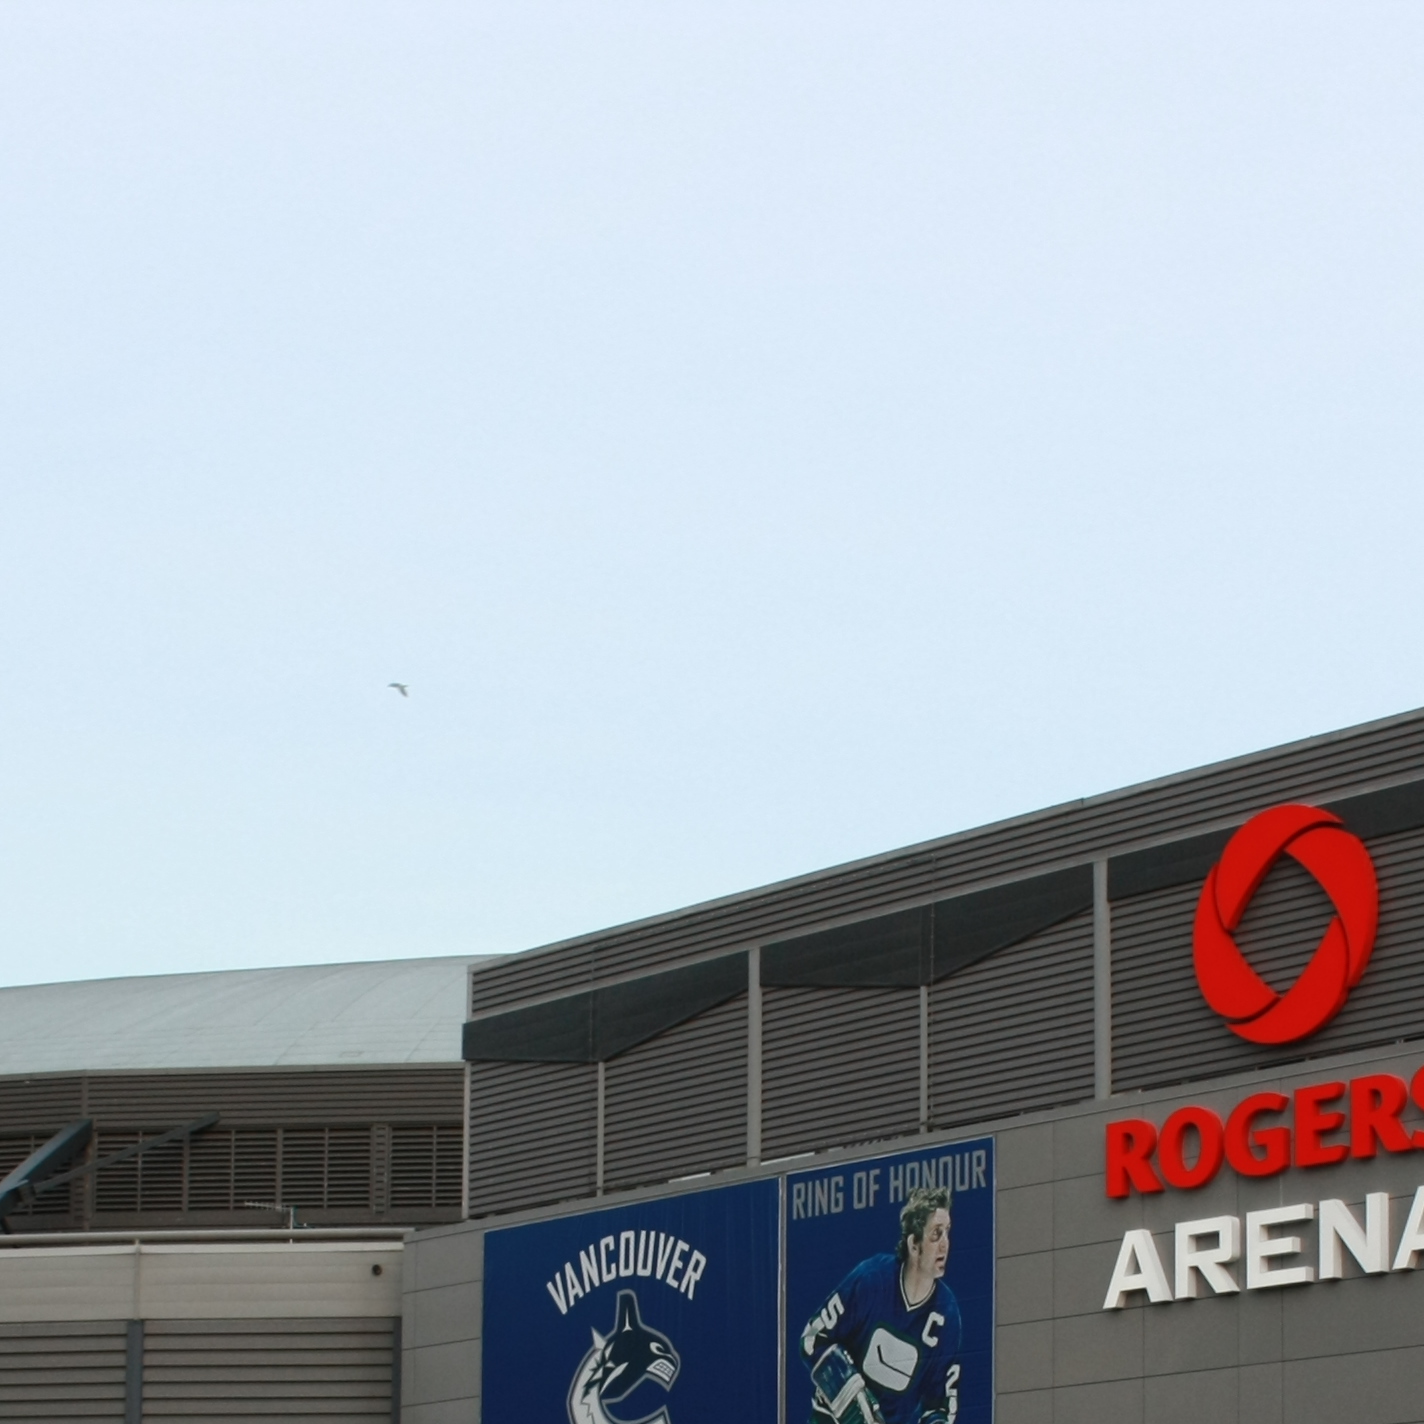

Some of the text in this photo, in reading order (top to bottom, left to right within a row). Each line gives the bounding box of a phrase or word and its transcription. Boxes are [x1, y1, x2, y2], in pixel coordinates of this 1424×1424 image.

[792, 1149, 987, 1220] RING OF HONOUR
[546, 1229, 707, 1316] VANCOUVER
